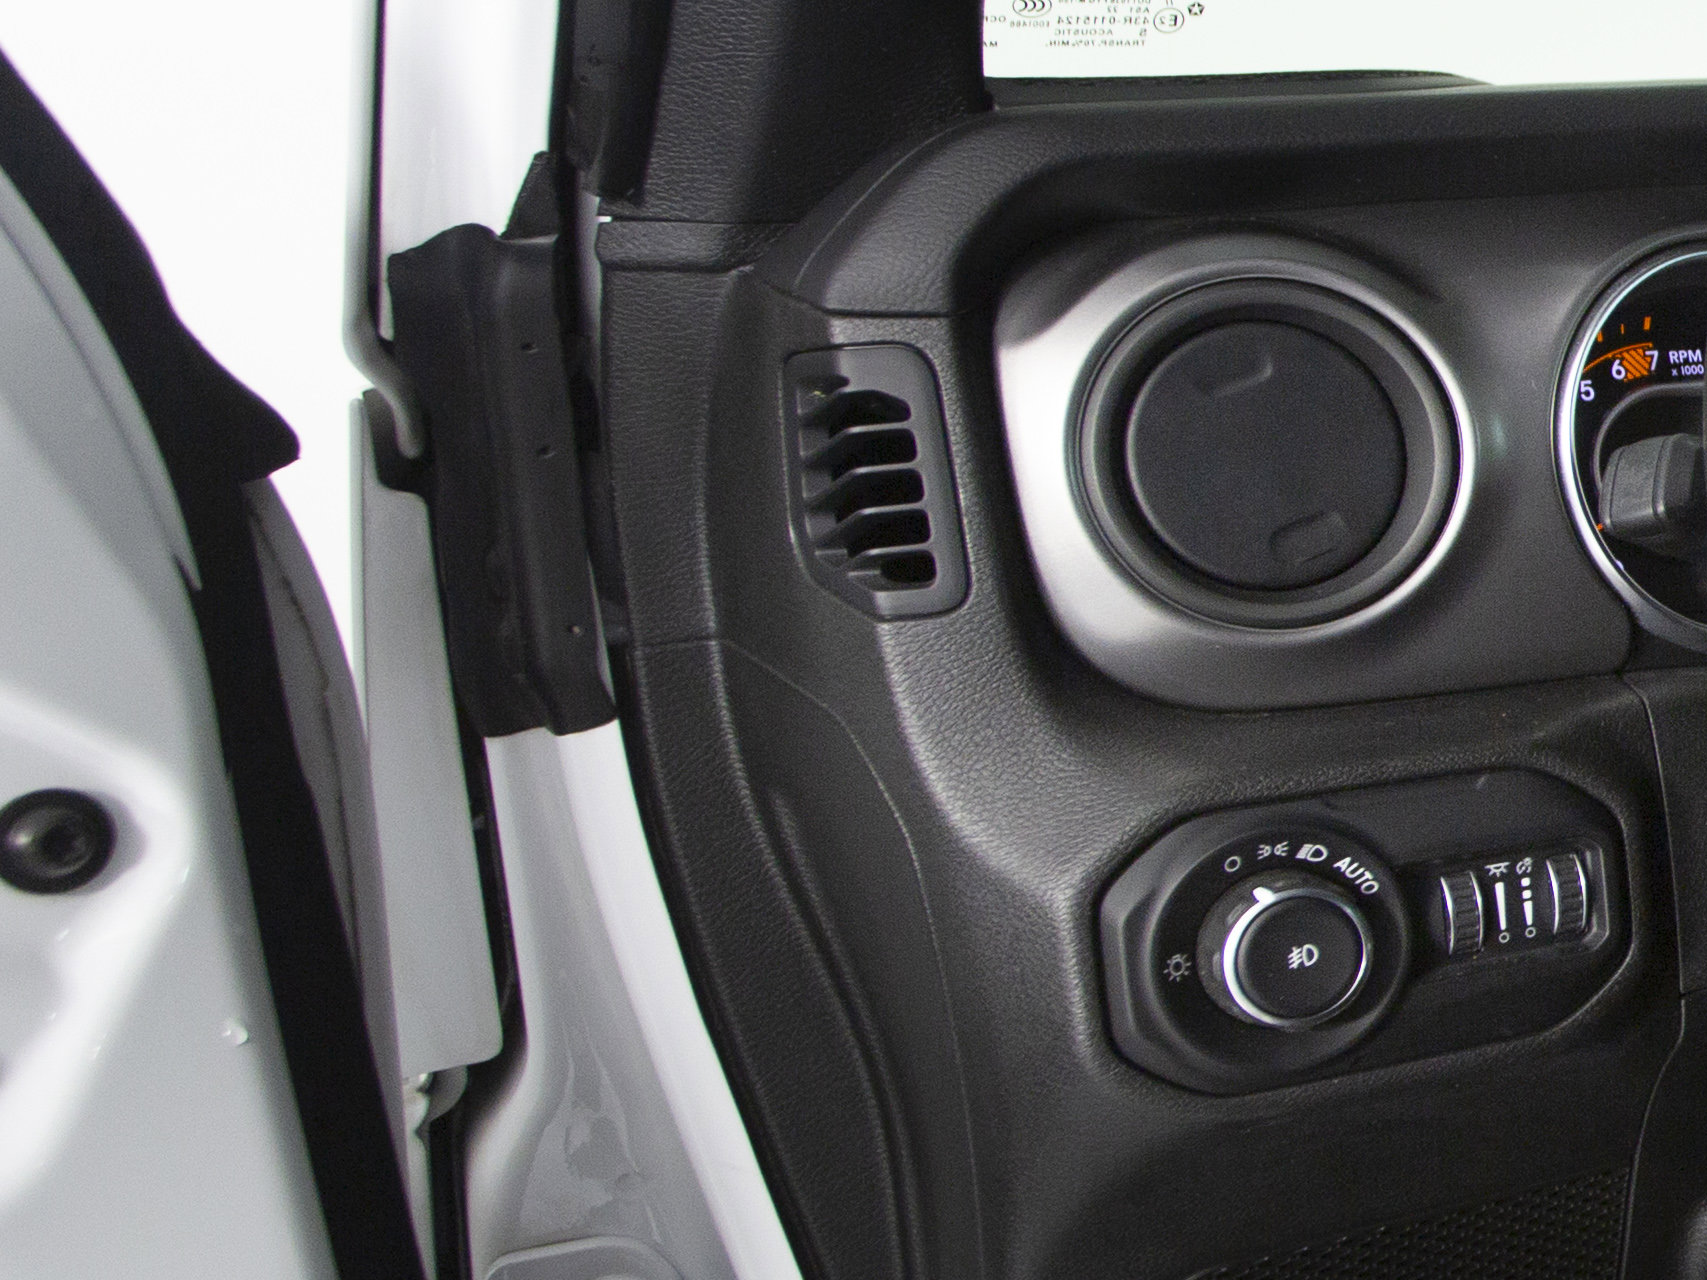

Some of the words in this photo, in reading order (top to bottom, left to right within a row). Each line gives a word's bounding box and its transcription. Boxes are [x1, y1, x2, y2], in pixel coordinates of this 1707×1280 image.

[1645, 350, 1659, 371] 7
[1668, 349, 1703, 364] RPM
[1611, 359, 1626, 380] 6
[1681, 365, 1705, 375] 1000
[1580, 380, 1595, 402] 5
[1333, 856, 1379, 896] AUTO
